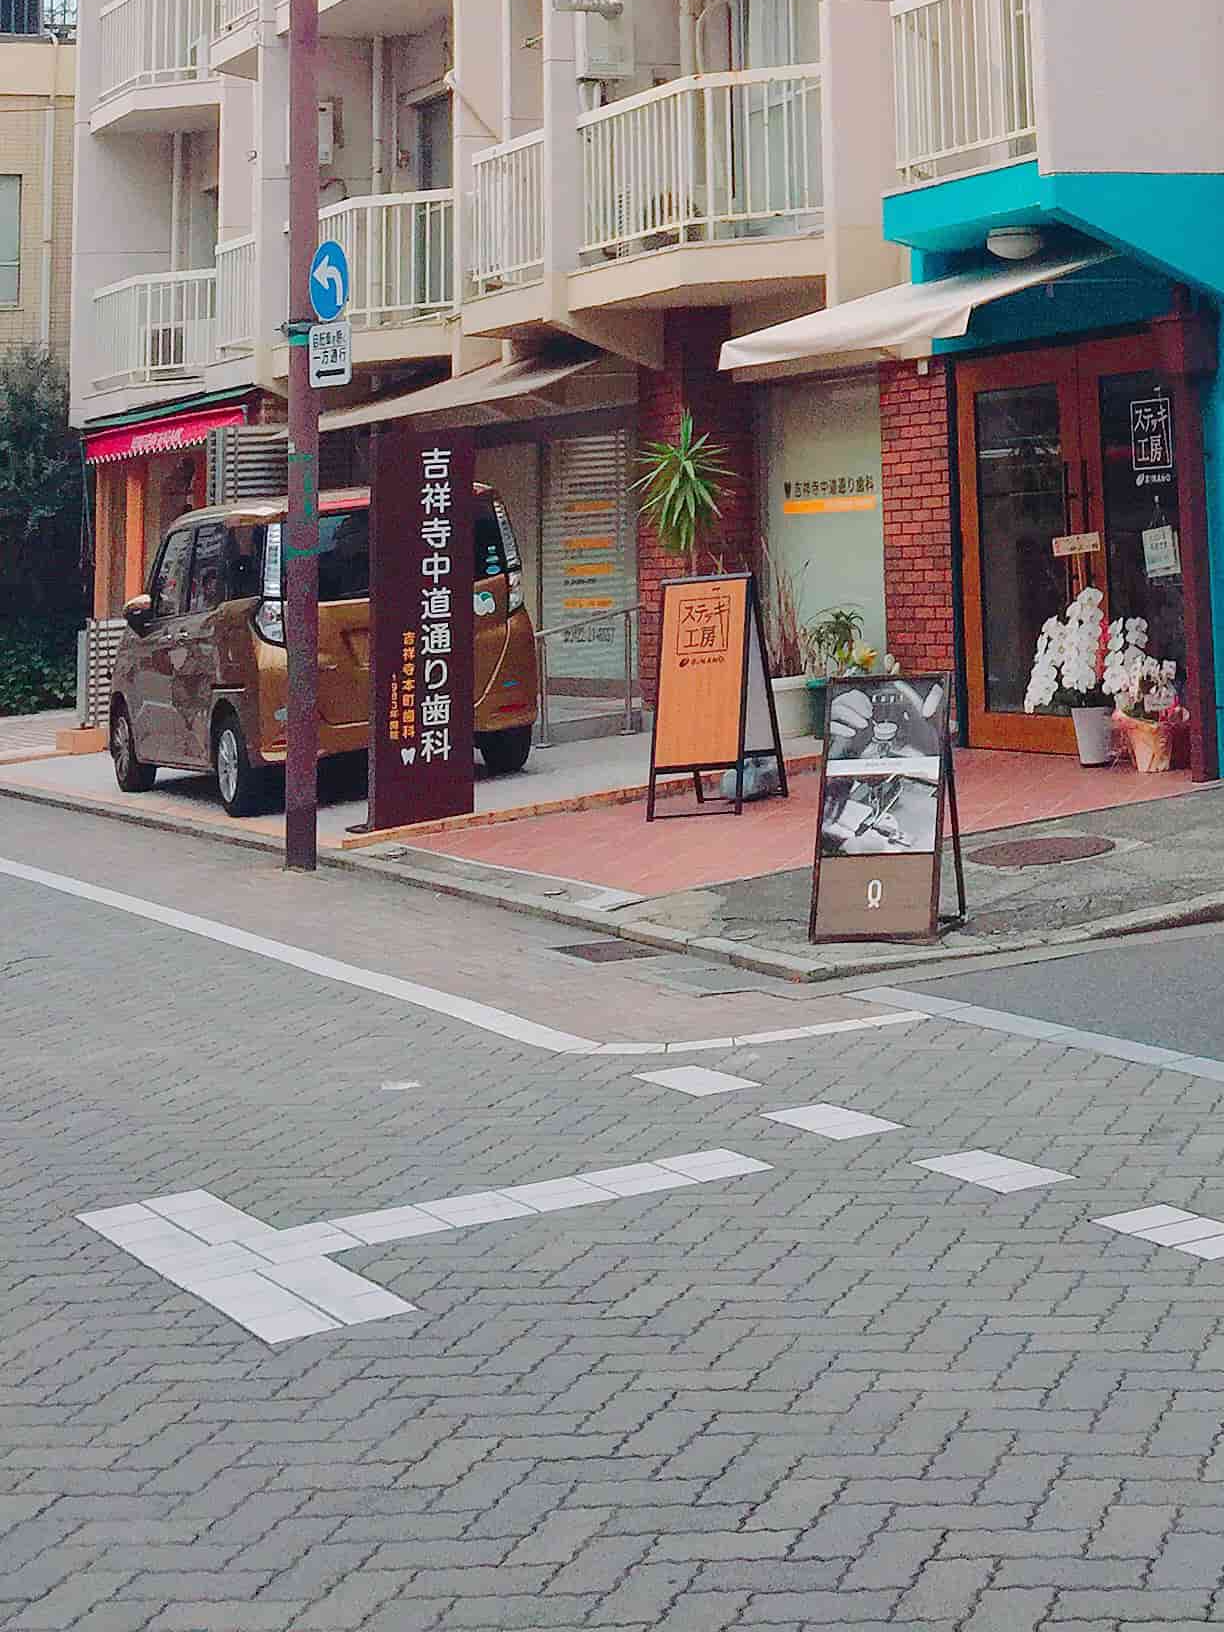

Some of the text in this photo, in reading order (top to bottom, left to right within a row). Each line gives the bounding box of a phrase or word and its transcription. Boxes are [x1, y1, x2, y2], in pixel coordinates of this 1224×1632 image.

[312, 348, 346, 365] 一方通行
[1137, 435, 1163, 462] 工房
[420, 448, 452, 763] 吉祥寺中道通り歯科
[683, 625, 716, 648] 工房
